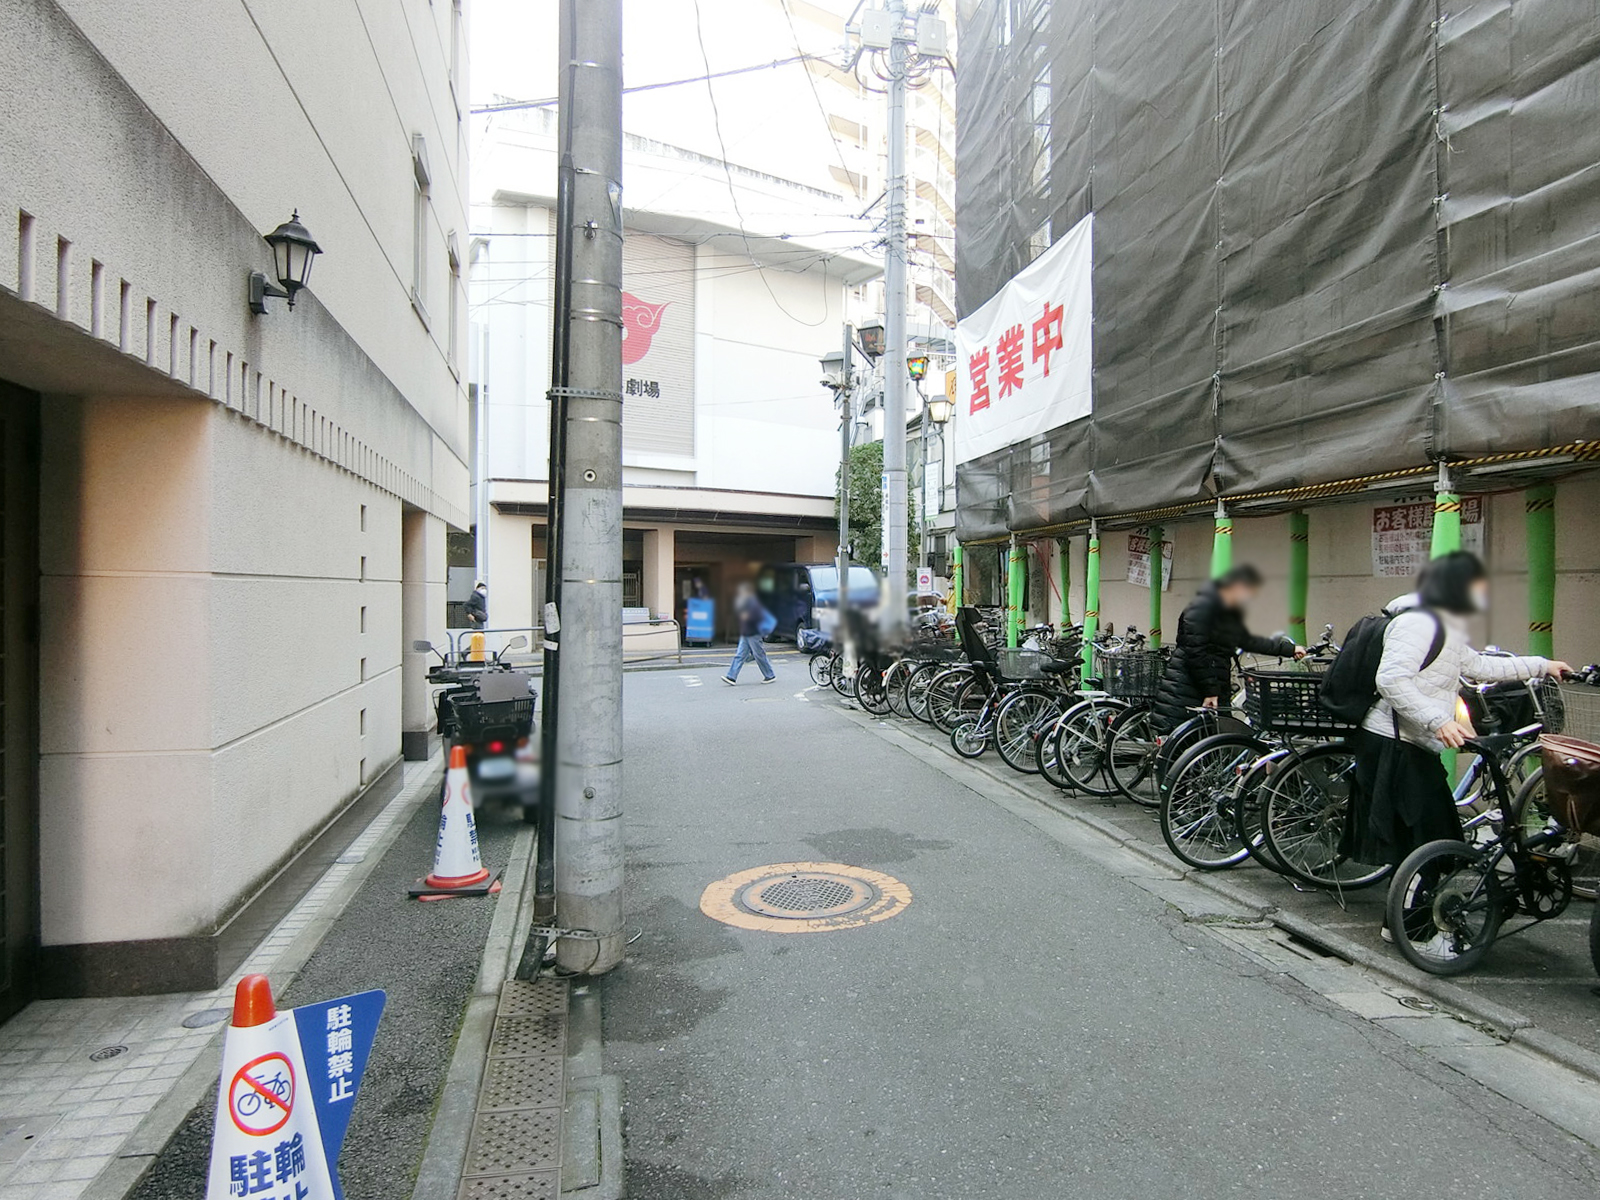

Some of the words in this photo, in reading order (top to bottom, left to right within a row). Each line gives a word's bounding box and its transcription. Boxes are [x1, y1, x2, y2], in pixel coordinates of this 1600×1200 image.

[625, 378, 660, 398] 劇場
[969, 301, 1064, 416] 営業中
[327, 1004, 354, 1104] 駐輪禁止
[229, 1131, 306, 1198] 駐輪
